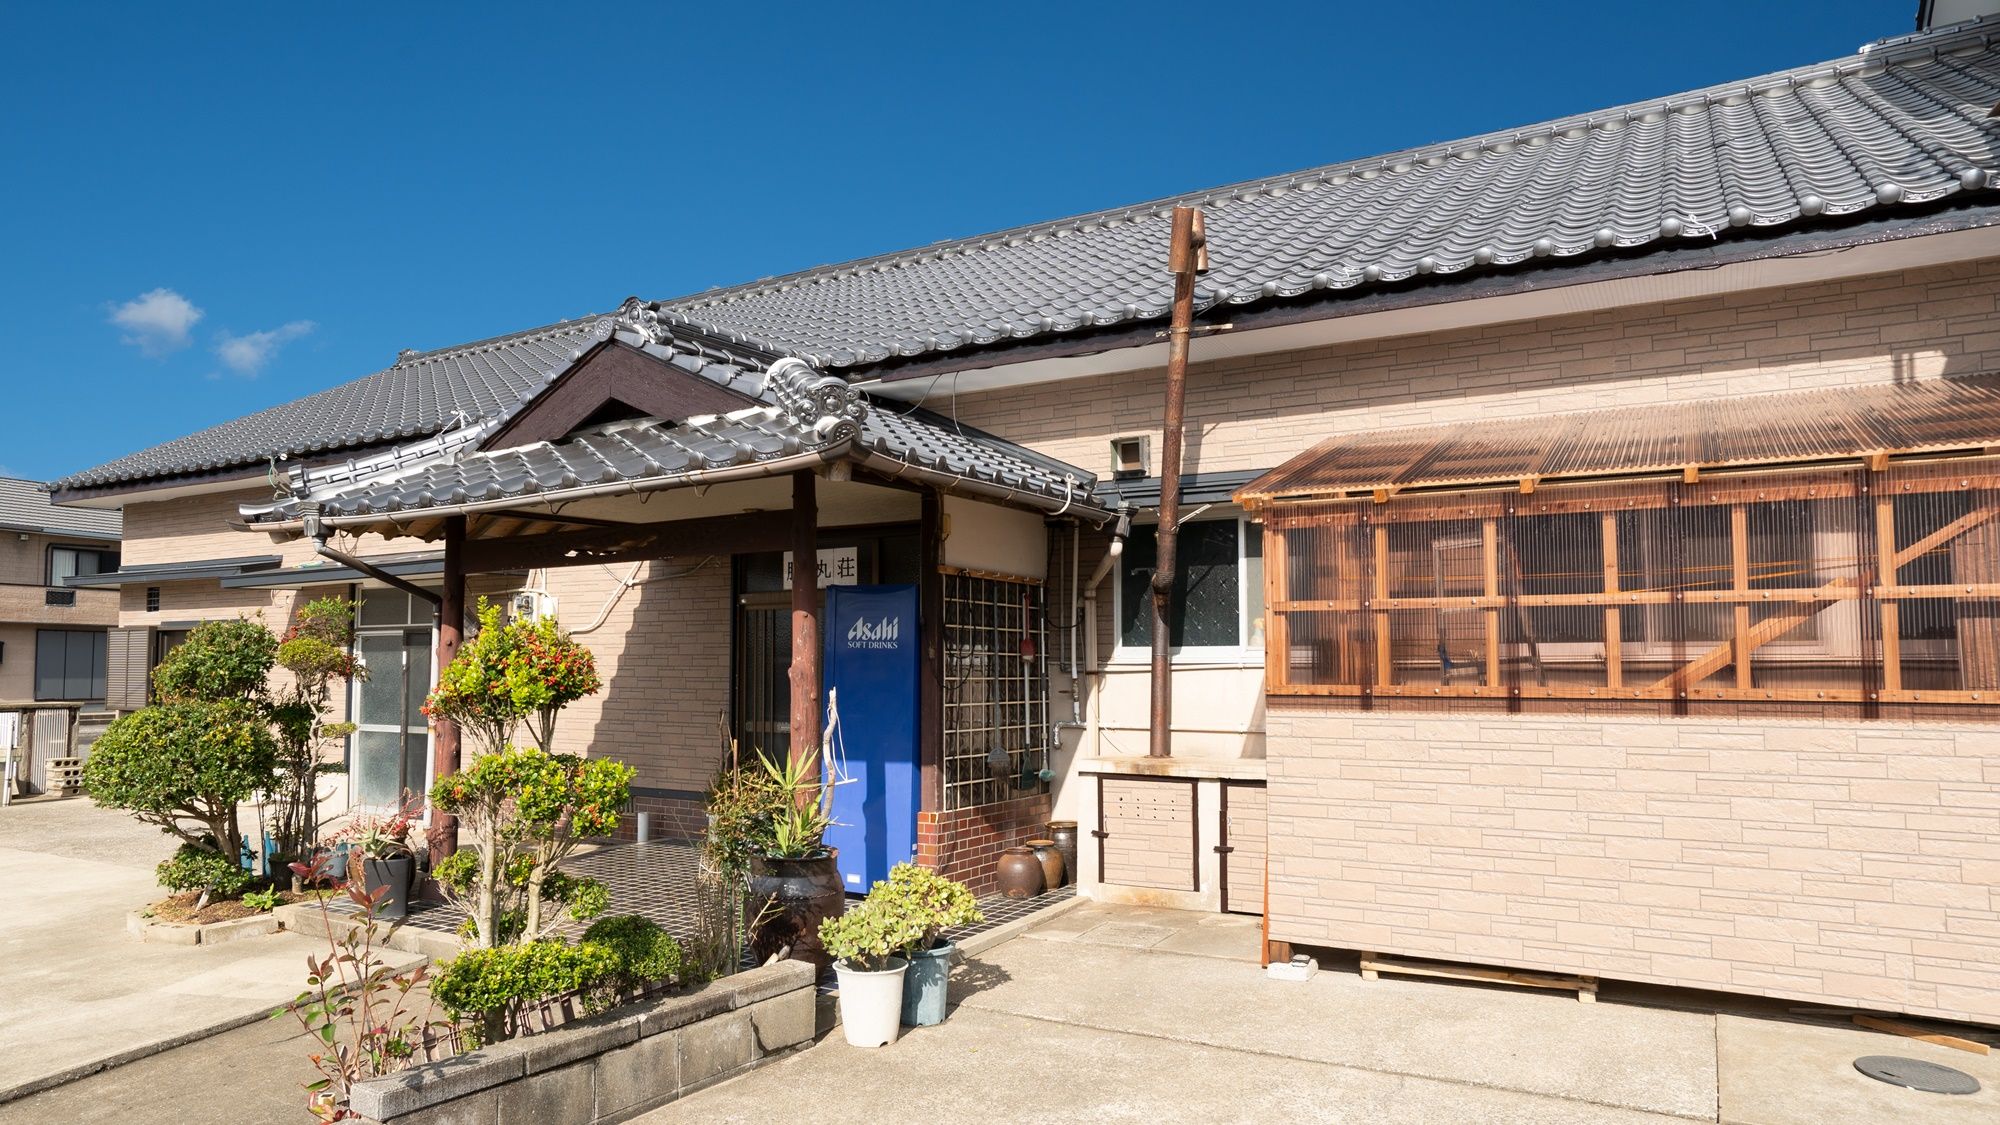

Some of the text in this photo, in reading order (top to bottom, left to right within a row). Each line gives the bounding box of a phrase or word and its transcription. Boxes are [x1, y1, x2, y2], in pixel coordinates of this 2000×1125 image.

[847, 616, 898, 641] Asahi
[847, 641, 898, 649] SOFT DRINKS
